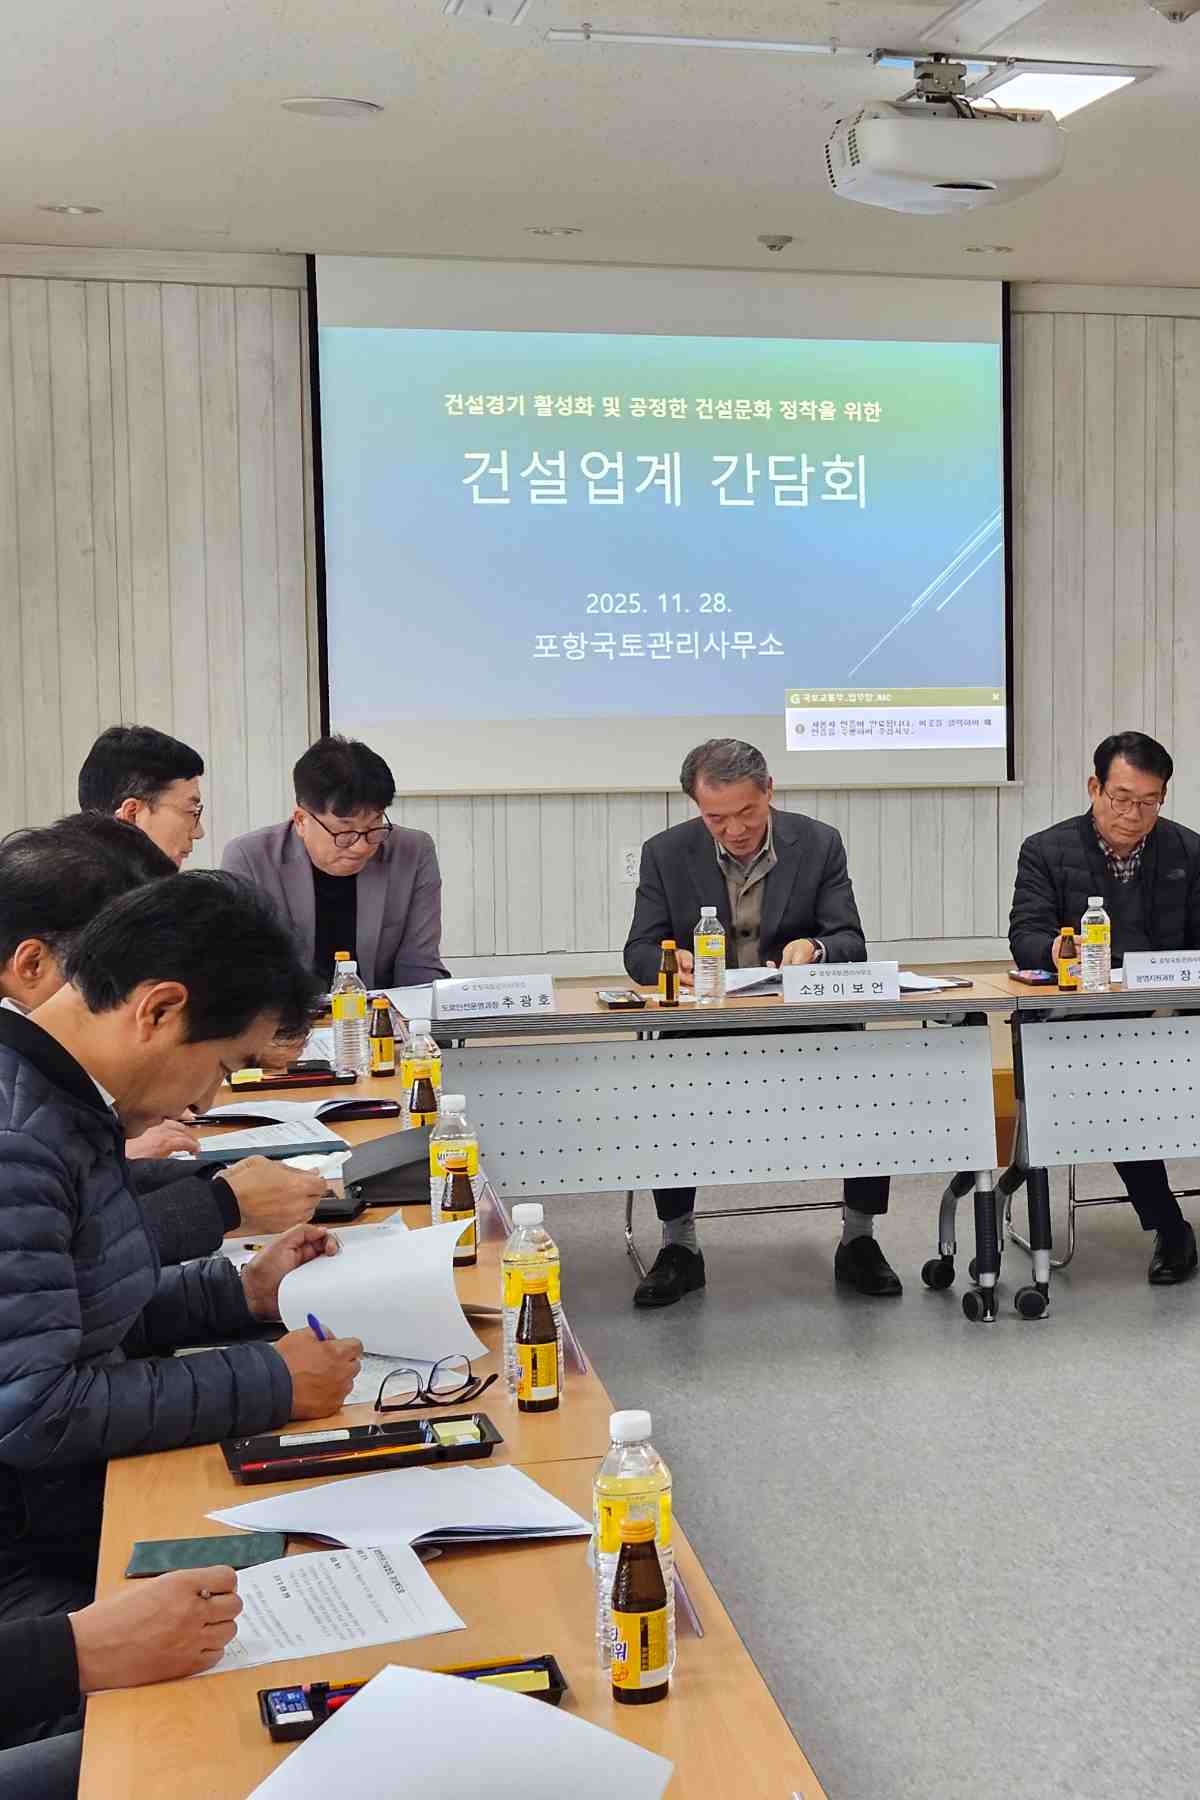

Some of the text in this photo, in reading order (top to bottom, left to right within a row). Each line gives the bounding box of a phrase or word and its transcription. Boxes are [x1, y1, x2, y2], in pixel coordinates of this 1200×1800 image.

[443, 393, 883, 423] 건설경기 활성화 및 공정한 건설문화 정착을 위한
[461, 449, 868, 509] 건설업계 간담회
[585, 592, 733, 614] 2025. 11. 28.
[532, 630, 785, 661] 포항국토관리사무소
